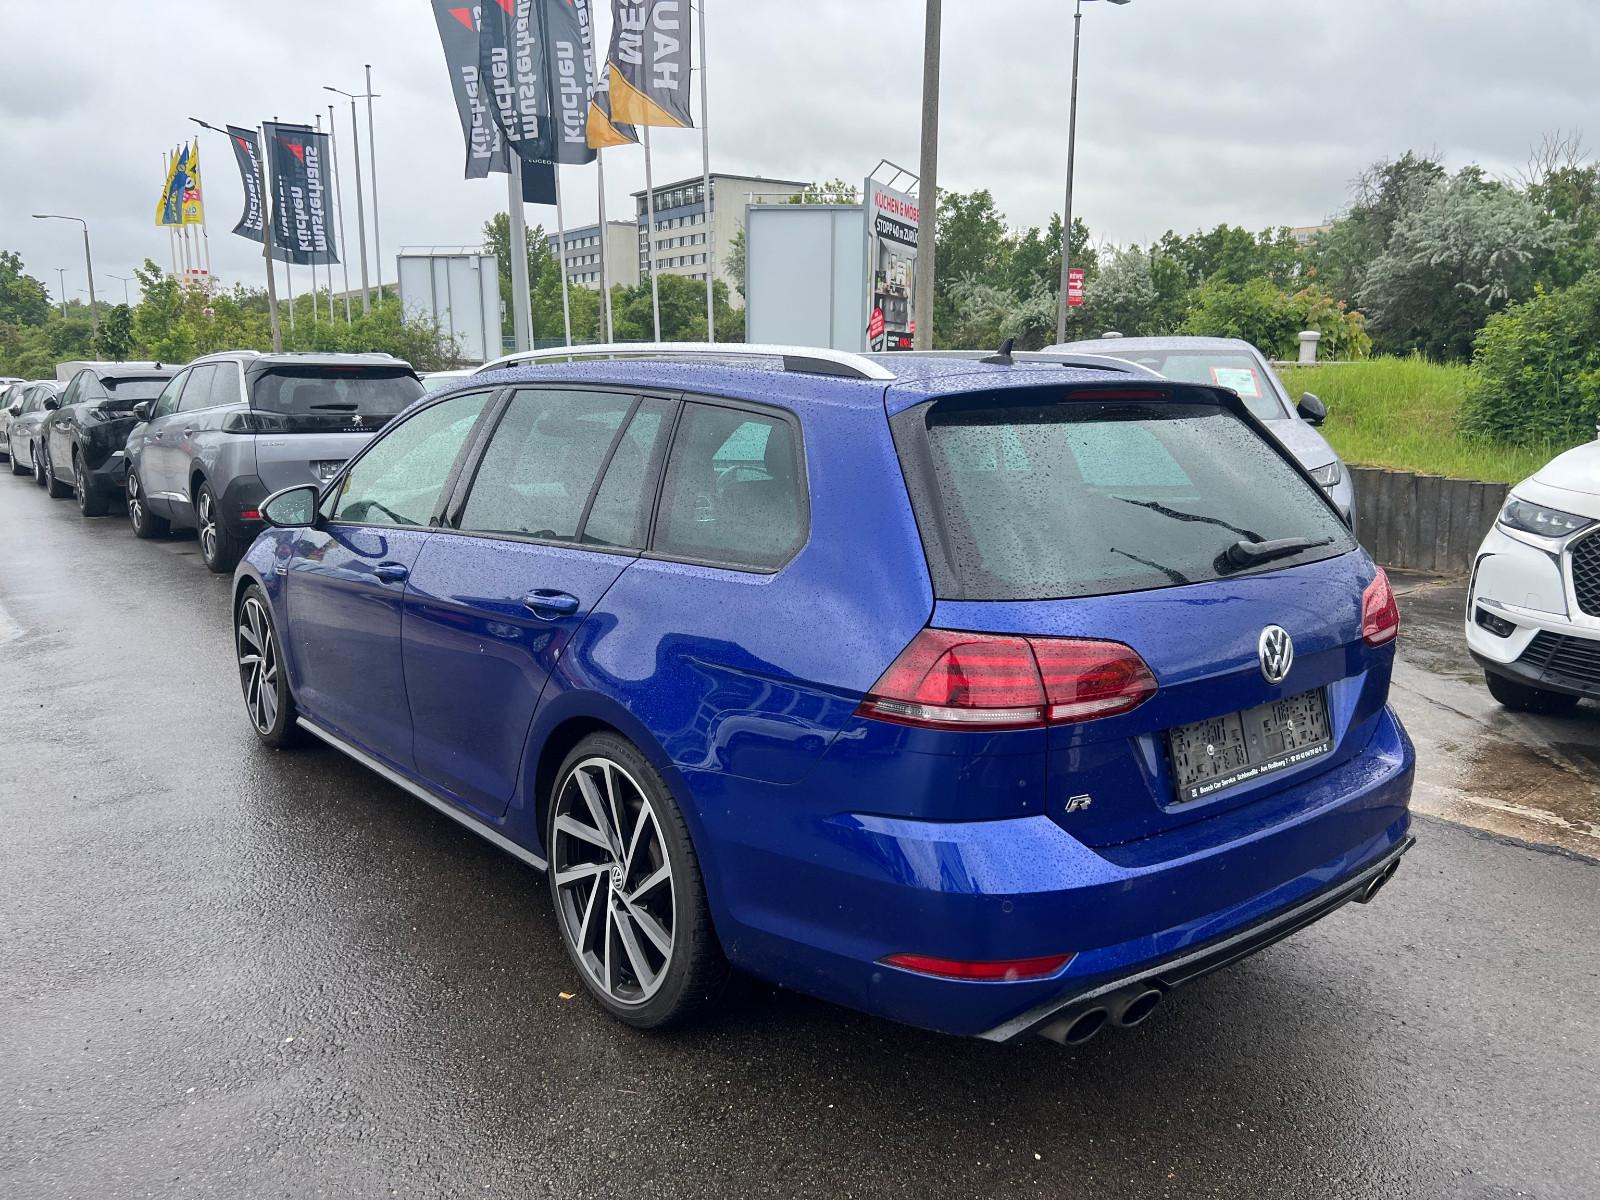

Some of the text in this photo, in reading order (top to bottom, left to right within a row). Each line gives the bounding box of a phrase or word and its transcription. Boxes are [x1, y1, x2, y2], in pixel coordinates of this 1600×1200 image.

[875, 189, 899, 215] KÜCHEN
[904, 202, 919, 222] MÖBE
[876, 218, 892, 235] STOPP
[893, 224, 900, 238] 40
[904, 227, 918, 244] ZURÜC
